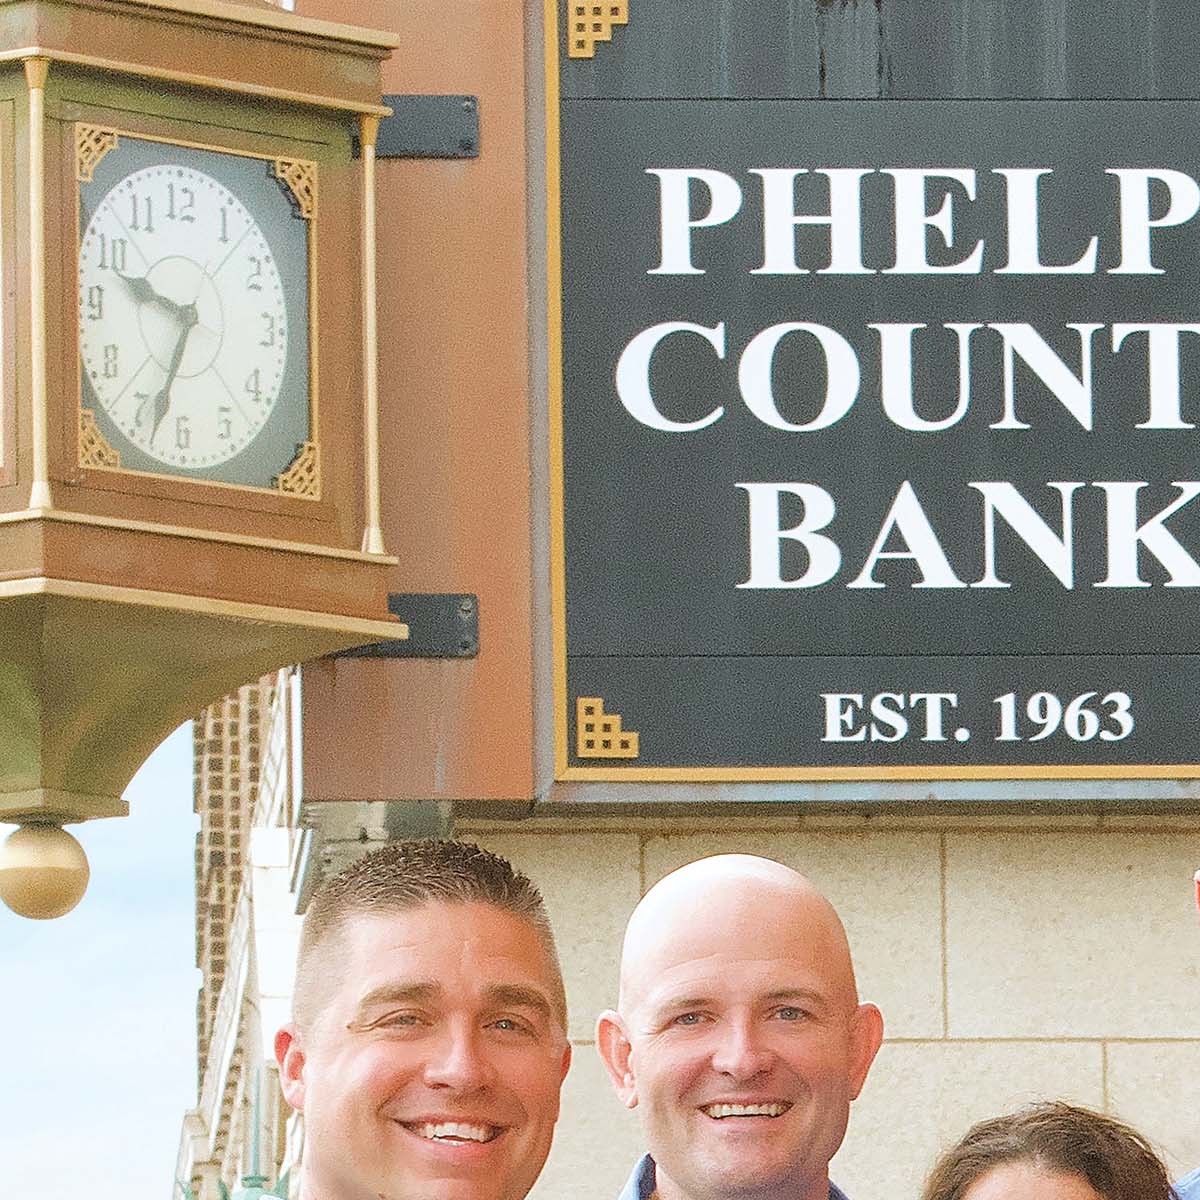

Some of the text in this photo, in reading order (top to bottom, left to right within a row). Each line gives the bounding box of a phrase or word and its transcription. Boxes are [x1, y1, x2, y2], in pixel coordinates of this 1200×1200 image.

[129, 193, 155, 234] 11
[166, 183, 196, 224] 12
[220, 207, 230, 243] 1
[97, 233, 128, 272] 10
[247, 256, 263, 292] 2
[87, 284, 104, 320] 9
[259, 312, 275, 348] 3
[102, 344, 119, 379] 8
[245, 368, 262, 402] 4
[133, 391, 150, 428] 7
[217, 406, 233, 440] 5
[175, 416, 190, 450] 6
[820, 691, 1136, 743] EST. 1963
